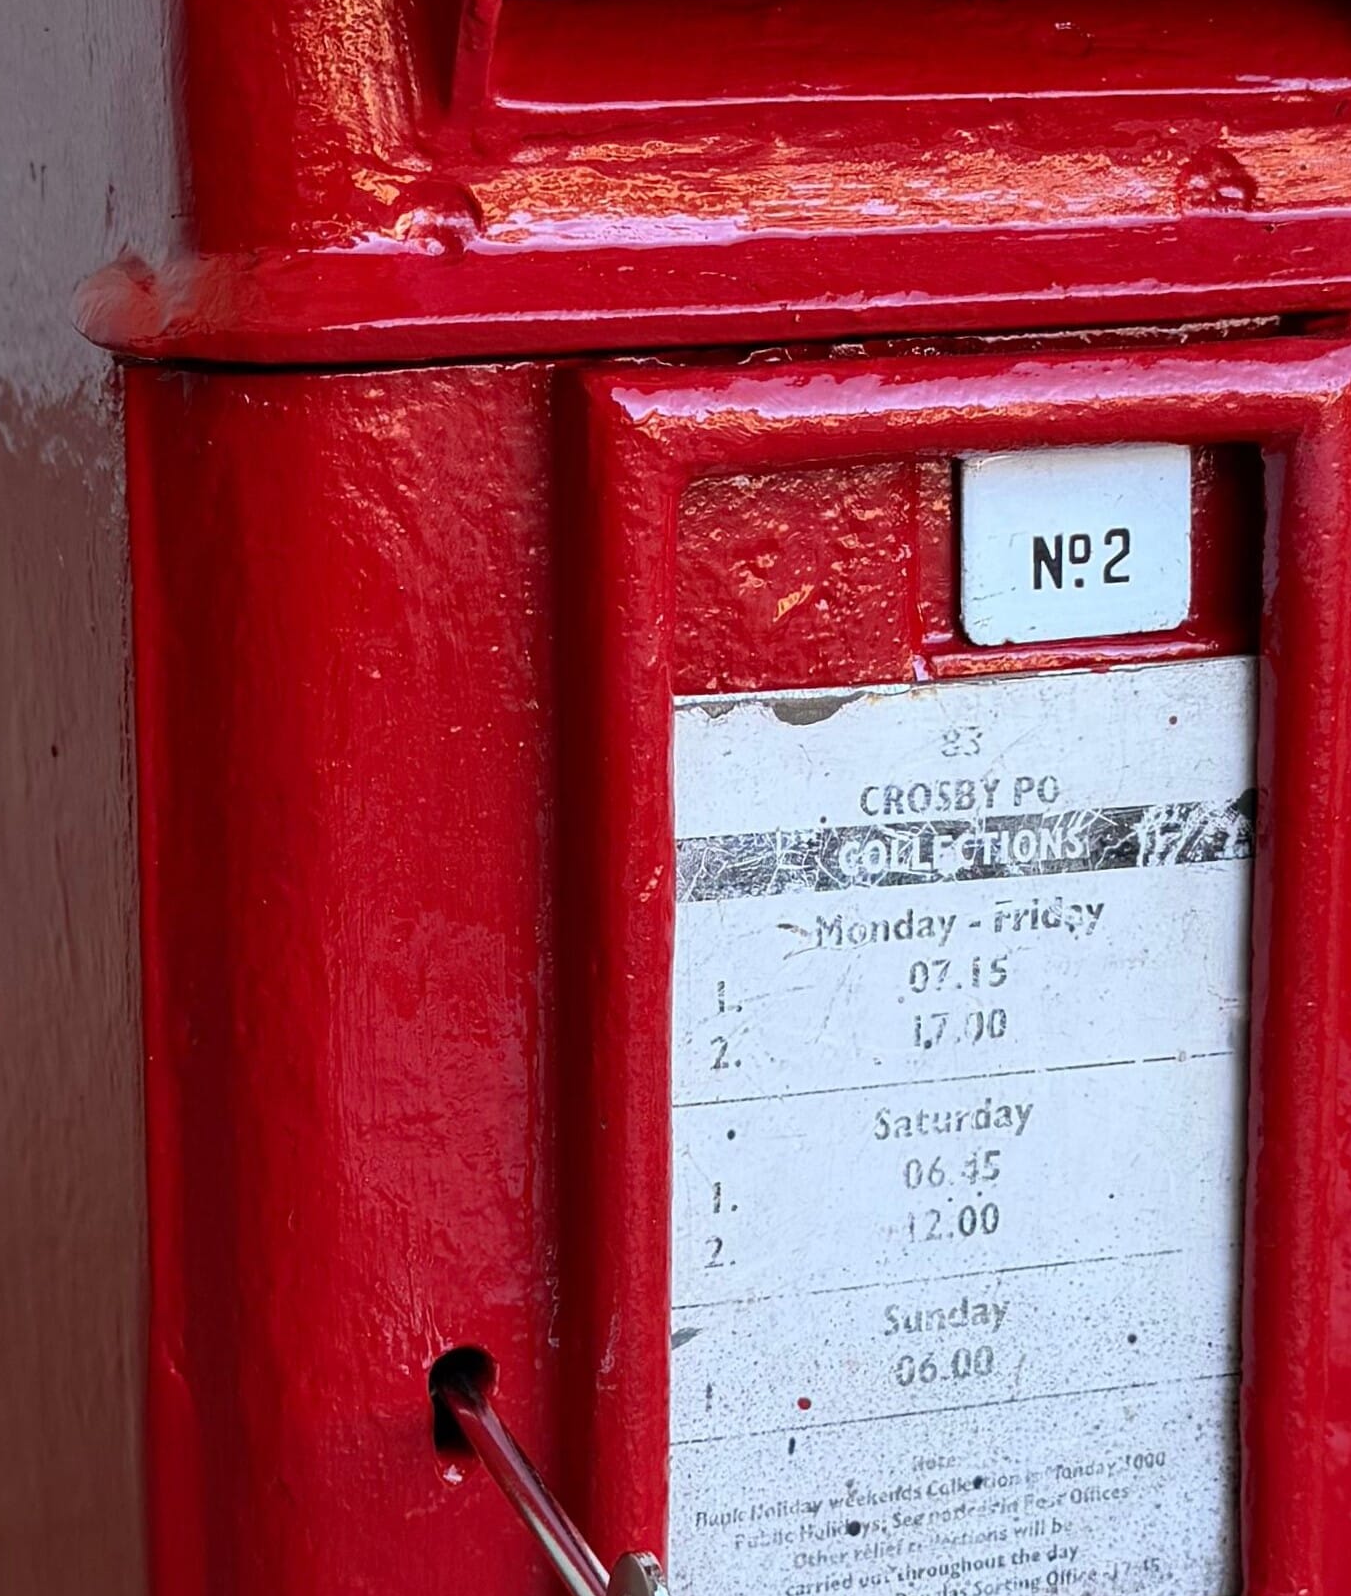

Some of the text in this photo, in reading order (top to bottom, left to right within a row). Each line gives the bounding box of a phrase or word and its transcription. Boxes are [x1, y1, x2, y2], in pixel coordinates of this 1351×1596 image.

[859, 775, 1061, 817] CROSBY PO
[838, 827, 1091, 877] COLLECTIONS
[815, 908, 956, 948] Monday
[994, 897, 1105, 936] Friday
[909, 954, 1009, 994] 07.15
[874, 1098, 1034, 1141] Saturday
[705, 1202, 1001, 1268] 2. 12.00
[884, 1296, 1010, 1336] Sunday
[894, 1344, 995, 1387] 06.00
[898, 1552, 1006, 1582] throughout
[1012, 1548, 1041, 1565] the
[1046, 1543, 1079, 1563] day
